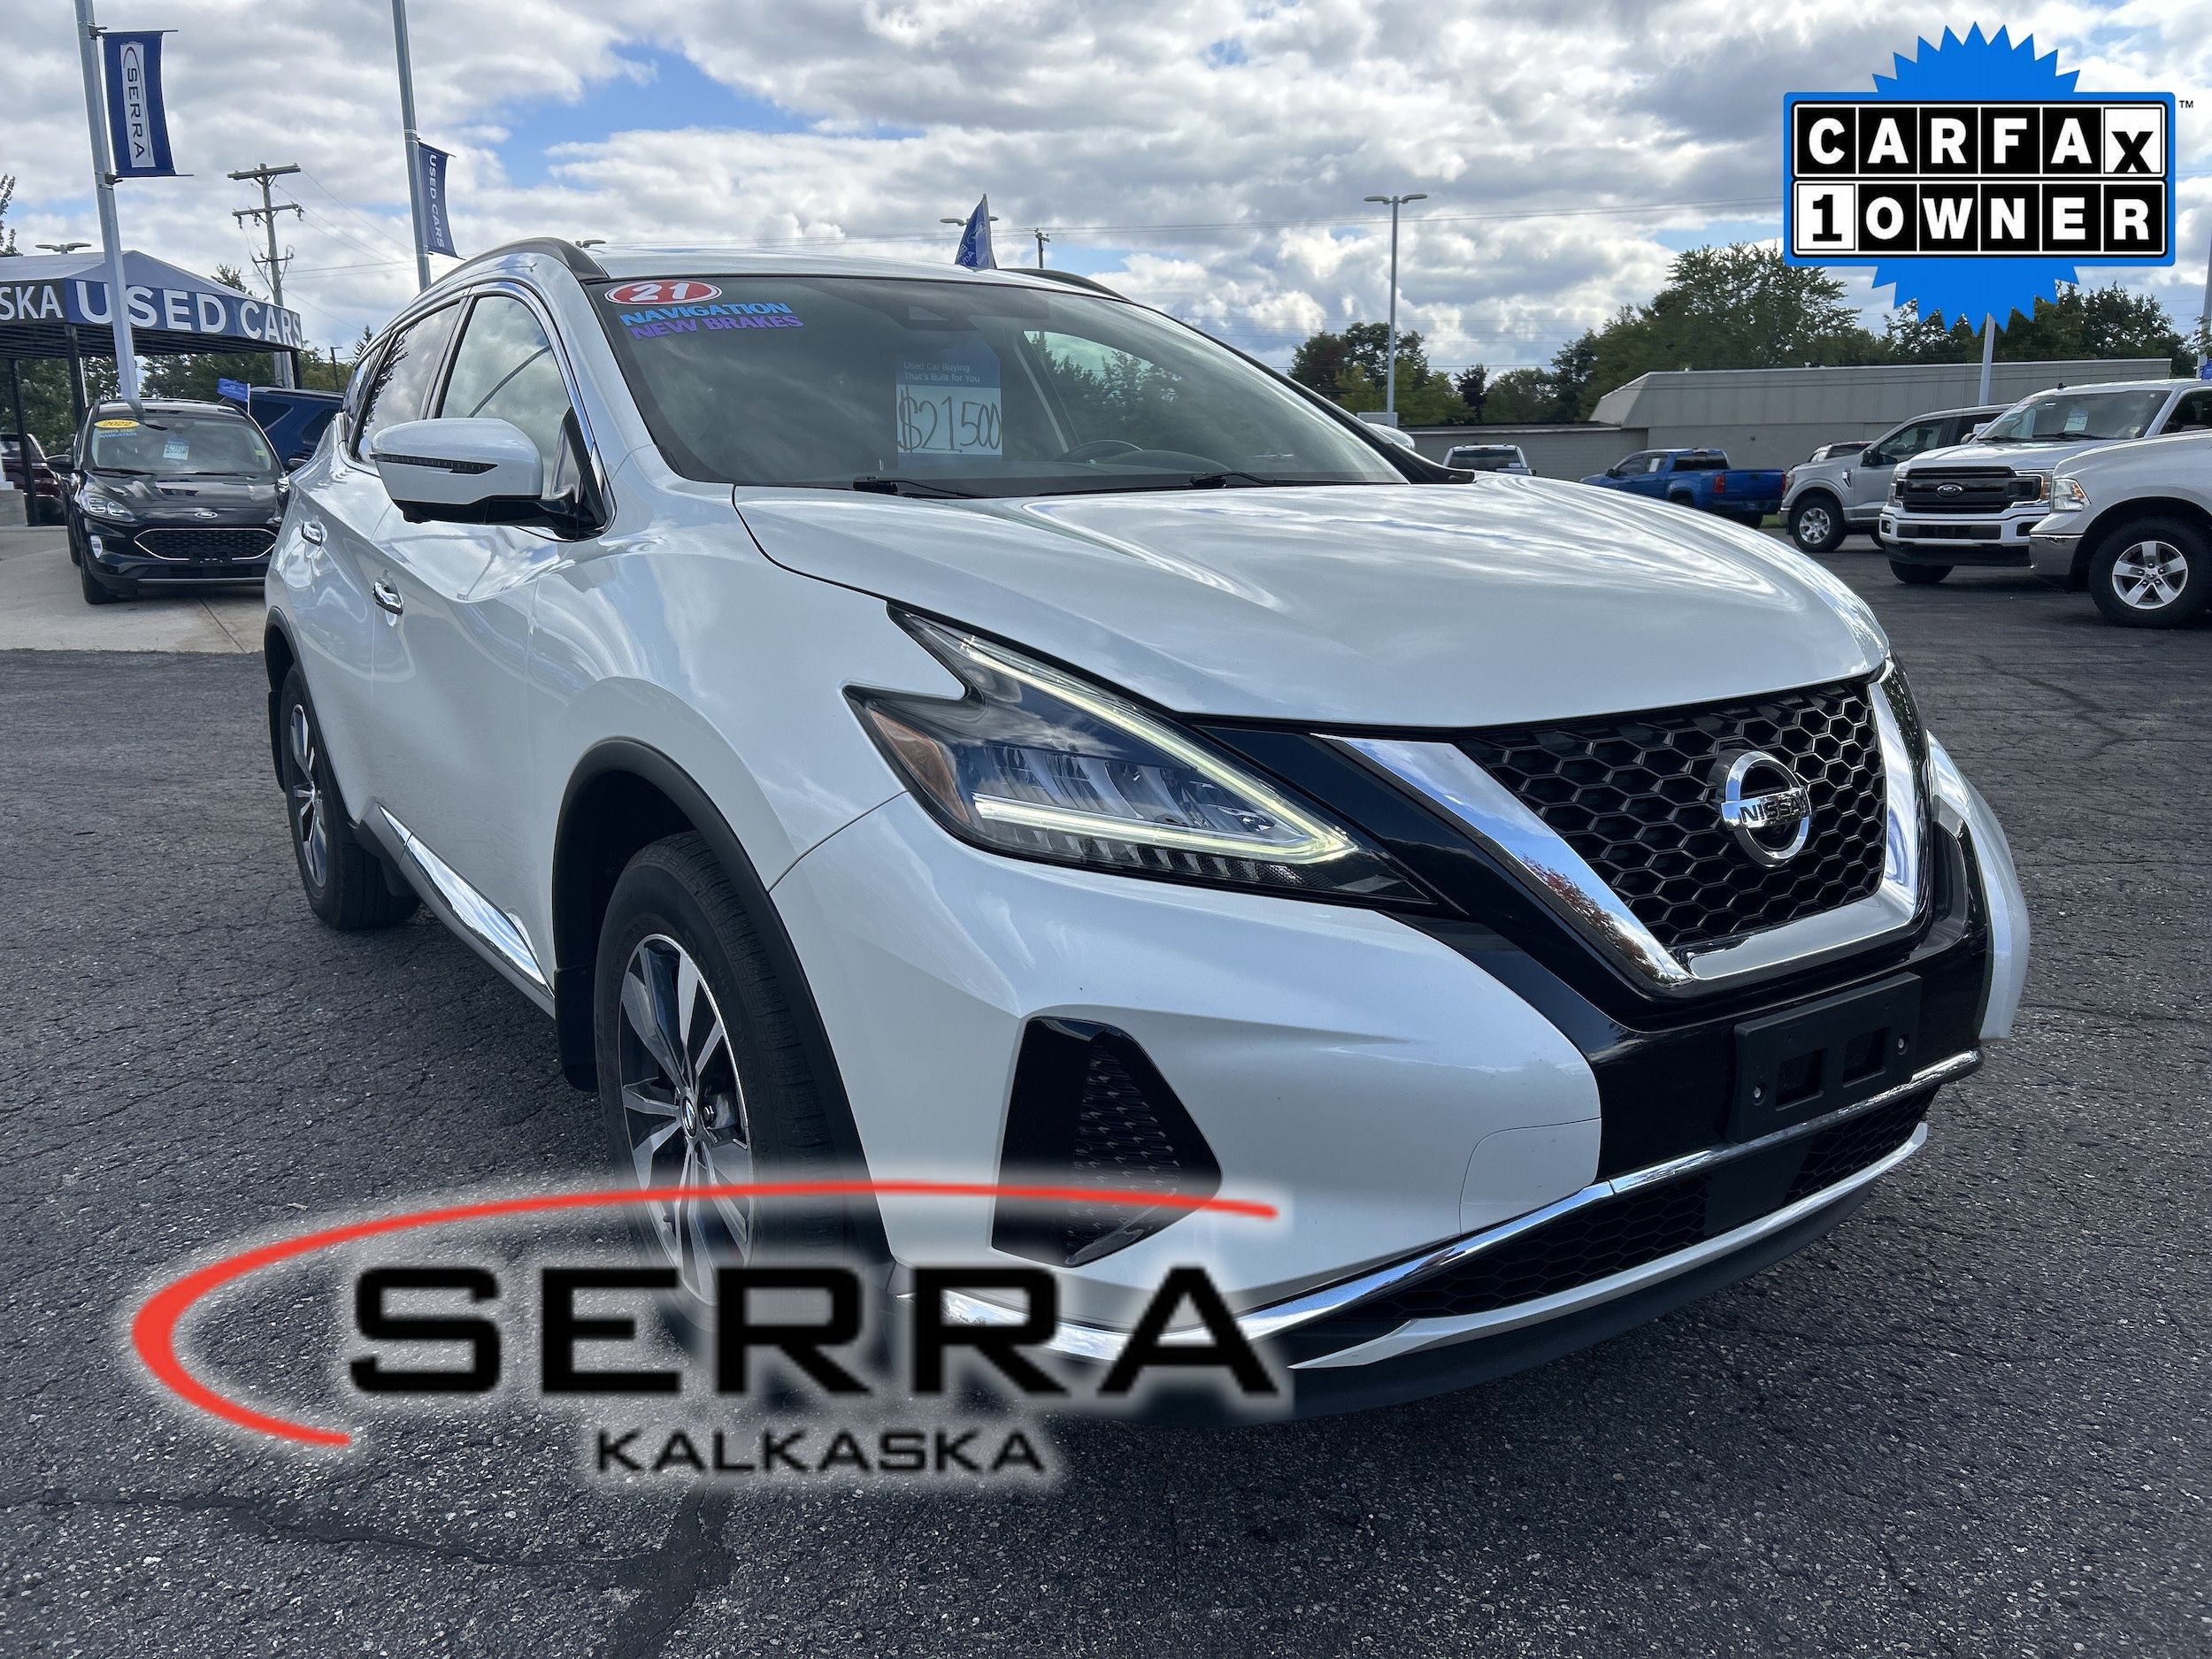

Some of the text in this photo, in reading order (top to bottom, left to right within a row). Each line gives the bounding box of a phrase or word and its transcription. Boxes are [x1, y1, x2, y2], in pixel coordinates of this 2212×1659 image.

[127, 67, 146, 159] SERRA
[429, 153, 444, 248] USED CARS
[629, 282, 690, 302] 21
[76, 280, 303, 349] USED CARS
[619, 302, 794, 327] NAVIGATION
[629, 314, 804, 342] NEW BRAKES
[903, 361, 971, 373] Used Car Buying
[904, 372, 929, 380] That's
[931, 373, 949, 381] Built
